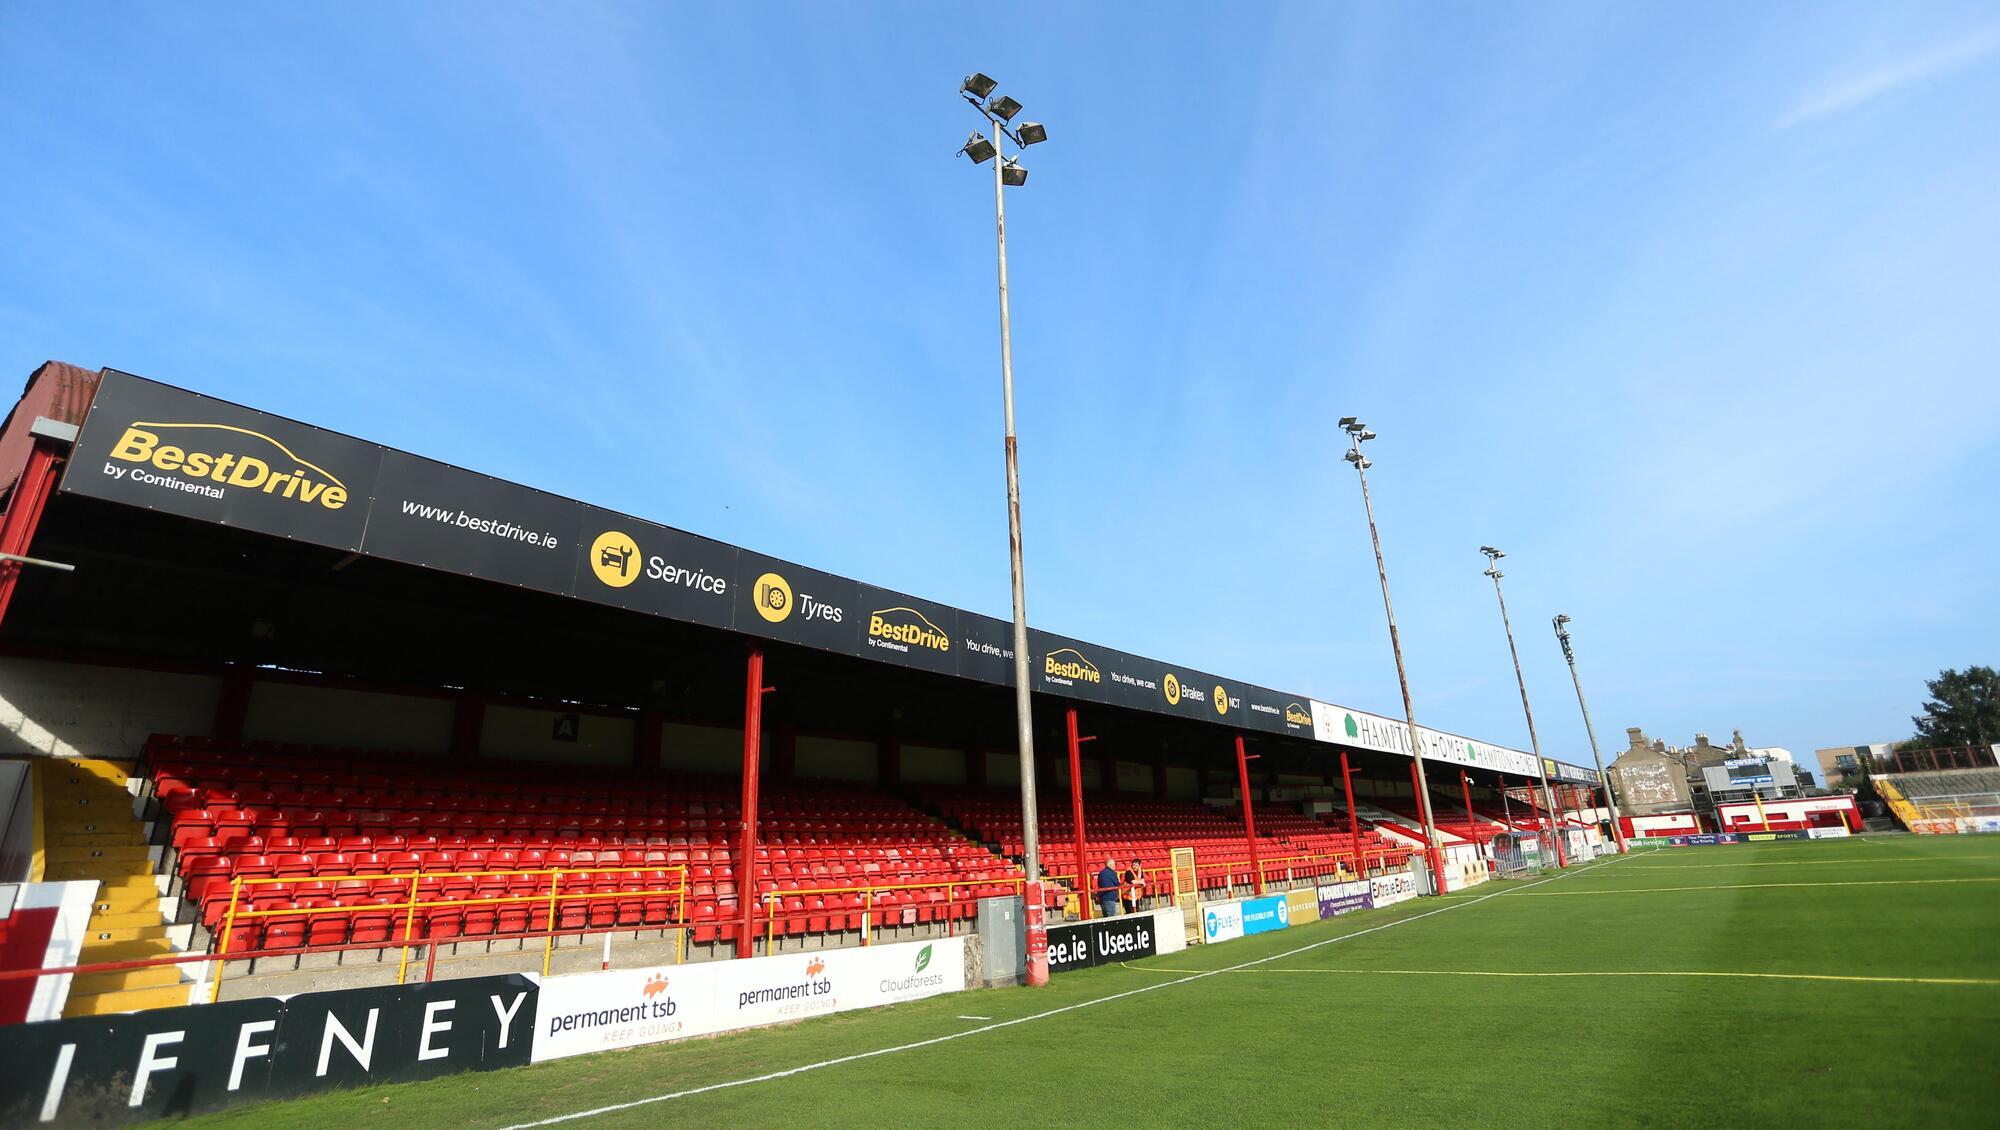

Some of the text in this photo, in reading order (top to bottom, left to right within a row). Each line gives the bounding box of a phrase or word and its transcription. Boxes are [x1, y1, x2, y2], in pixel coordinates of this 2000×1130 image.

[103, 463, 225, 500] by Continental
[109, 427, 348, 510] BestDrive
[402, 499, 558, 550] www.bestdrive.ie
[646, 556, 726, 595] Service
[798, 594, 842, 623] Tyres
[868, 637, 908, 653] by Continental
[869, 615, 949, 652] BestDrive
[966, 639, 1014, 659] You drive, we
[1045, 657, 1100, 683] BestDrive
[1111, 671, 1121, 682] You
[1136, 679, 1144, 687] we
[1181, 684, 1204, 702] Brakes
[1229, 697, 1240, 709] NCT
[1360, 717, 1467, 761] HAMPTOS HOMES
[1098, 925, 1150, 956] Usee.ie
[739, 977, 831, 1009] permanent tsb
[880, 974, 943, 993] Cloudforests
[550, 997, 676, 1038] permanent tsb
[778, 999, 832, 1015] KEEP GOING
[603, 1022, 676, 1043] KEEP GOING
